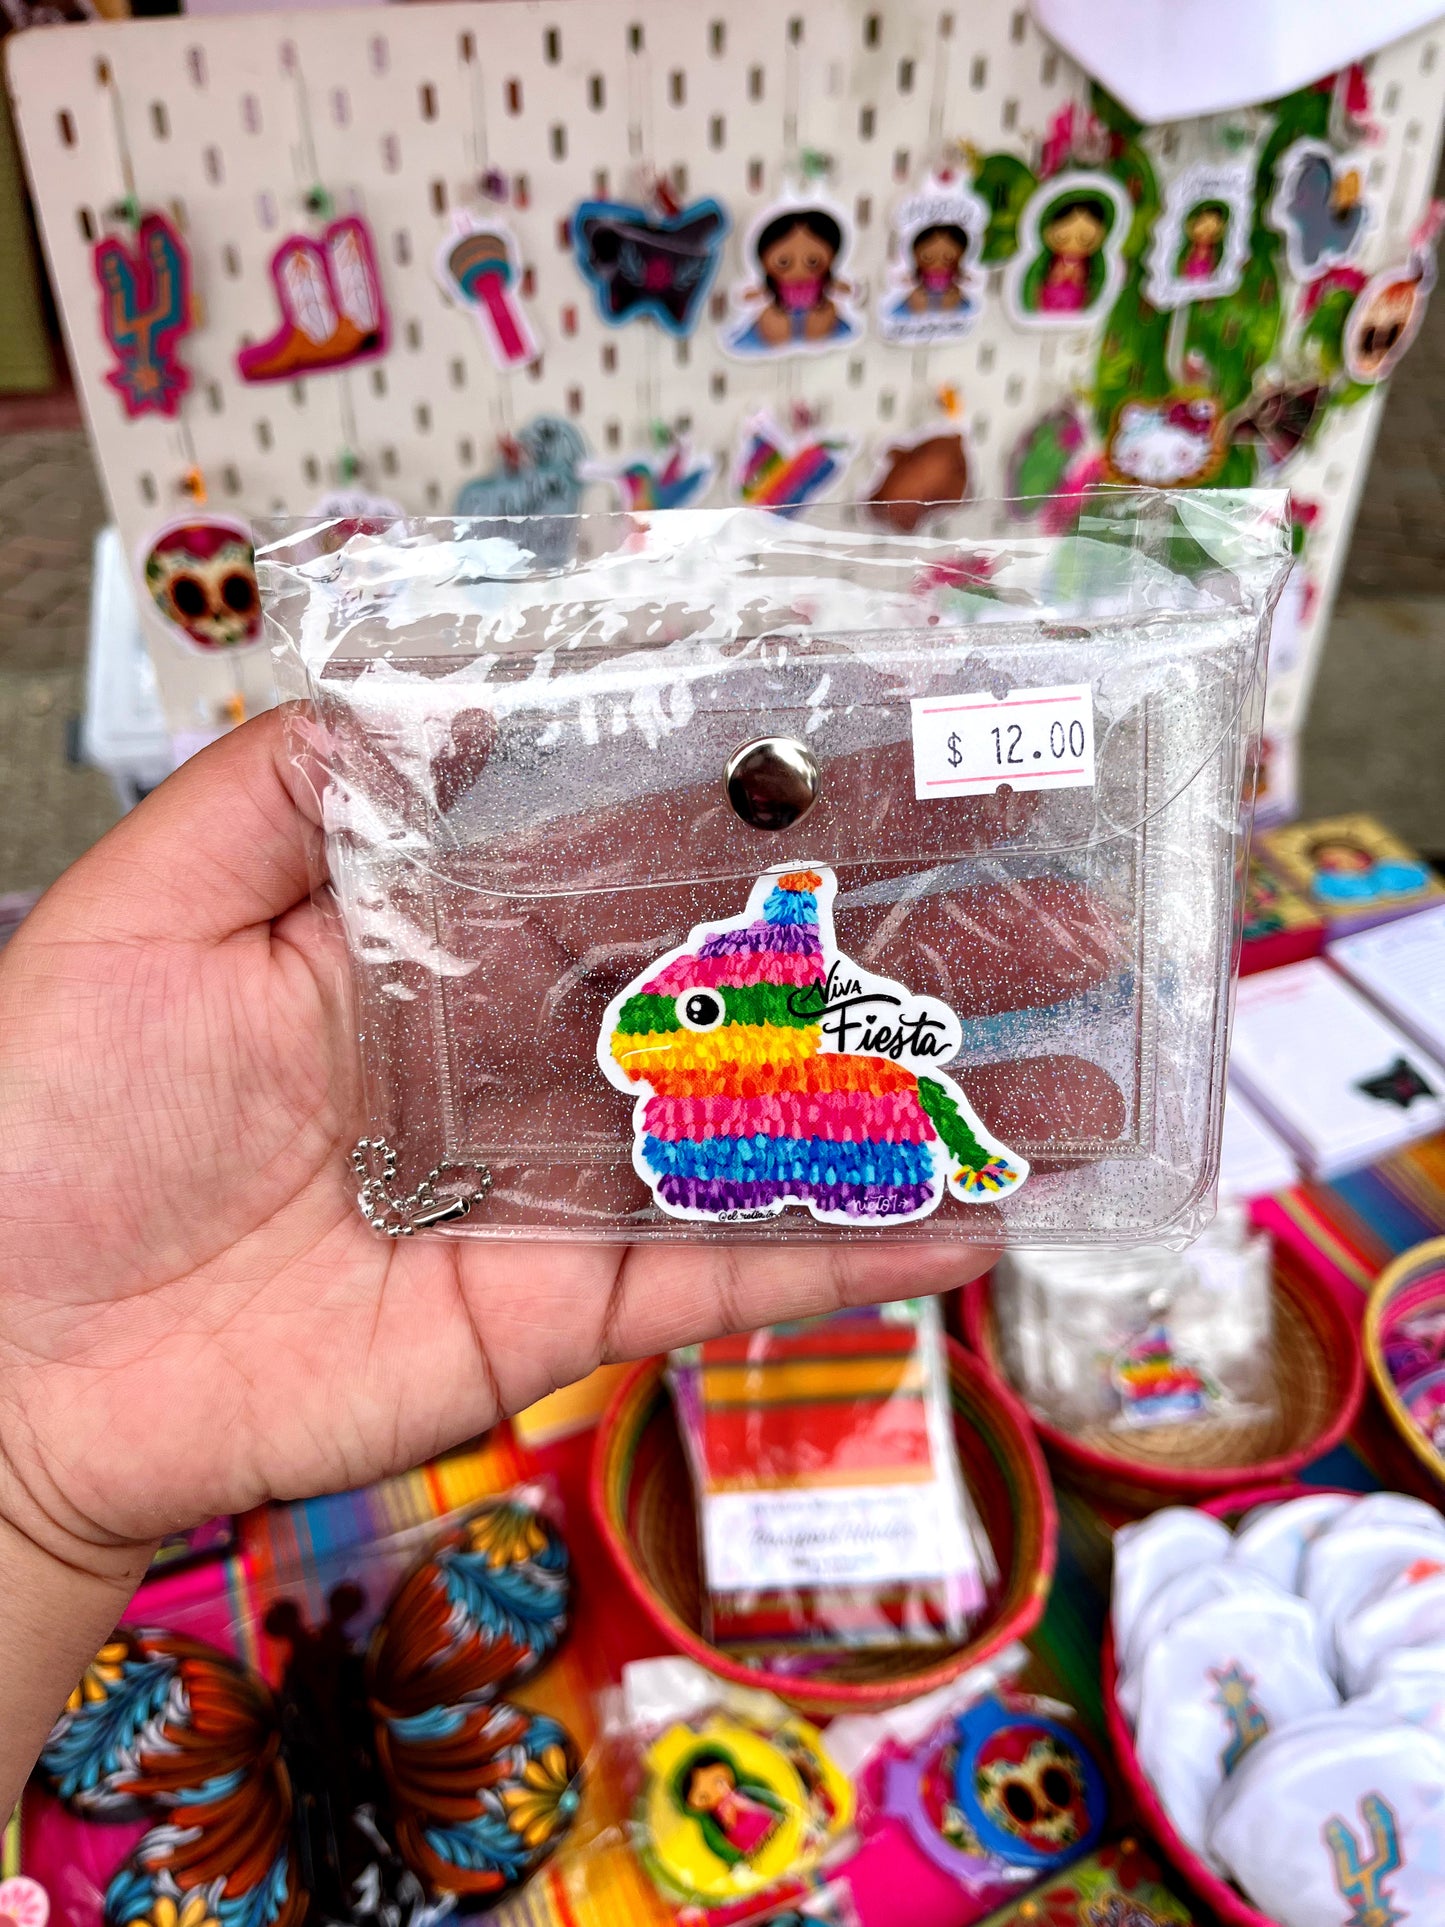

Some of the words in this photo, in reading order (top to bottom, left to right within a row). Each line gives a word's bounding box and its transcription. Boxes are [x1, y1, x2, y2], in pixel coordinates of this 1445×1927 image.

[947, 731, 963, 768] $
[990, 720, 1085, 765] 12.00
[821, 996, 953, 1060] Fiesta
